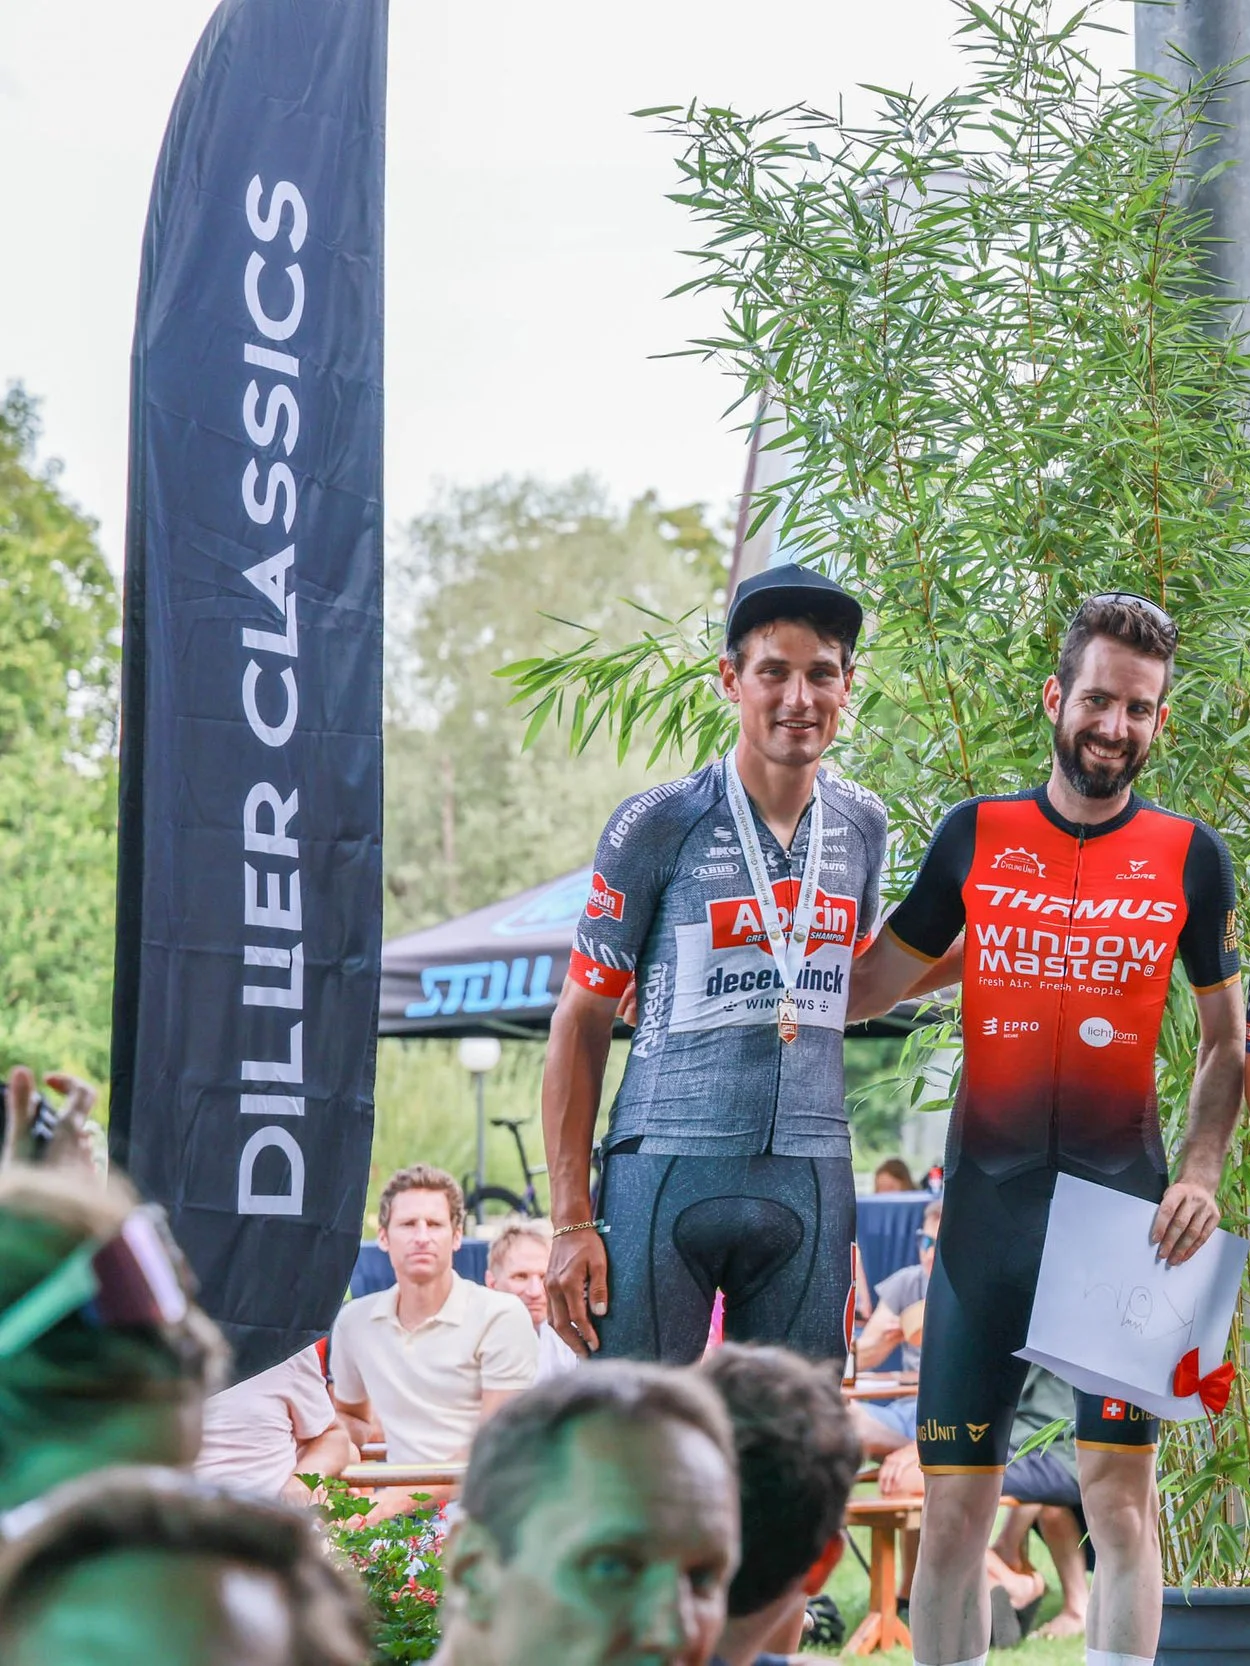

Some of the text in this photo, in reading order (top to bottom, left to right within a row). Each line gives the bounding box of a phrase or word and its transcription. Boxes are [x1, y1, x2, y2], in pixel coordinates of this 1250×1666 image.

[242, 174, 308, 747] CLASSICS
[699, 864, 735, 875] ABUS
[810, 931, 845, 943] SHAMPOO
[978, 976, 1124, 996] Fresh Air. Fresh People.
[632, 963, 663, 1058] Alpecin
[1003, 1022, 1040, 1032] EPRO
